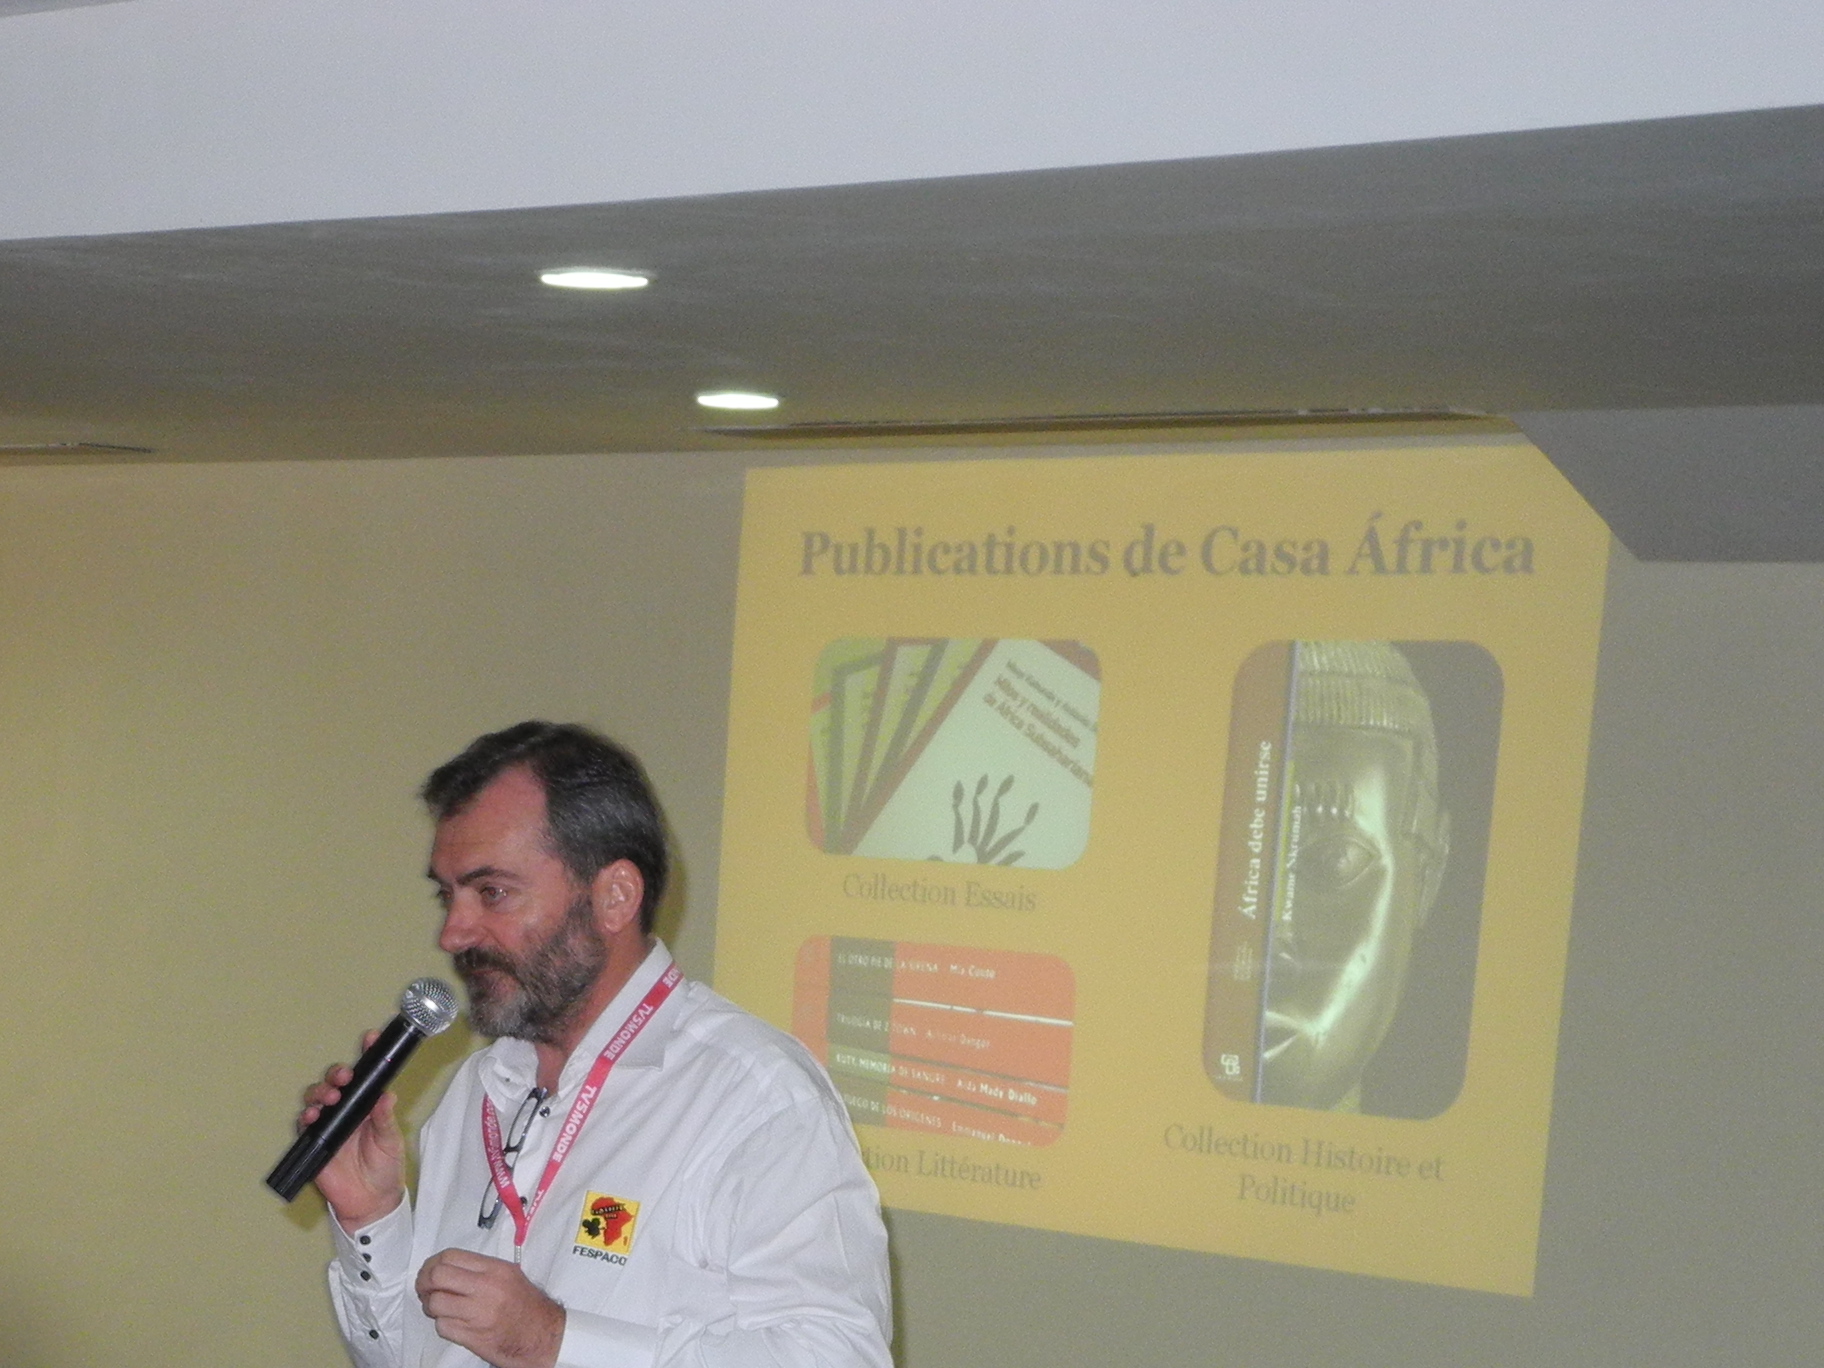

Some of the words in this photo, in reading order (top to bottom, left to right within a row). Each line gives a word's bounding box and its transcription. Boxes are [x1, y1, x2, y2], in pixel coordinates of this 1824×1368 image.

[798, 525, 1110, 577] Publications
[1122, 523, 1188, 577] de
[1201, 524, 1330, 576] Casa
[1348, 511, 1536, 576] África
[1254, 740, 1273, 802] unirse
[842, 872, 956, 907] Collection
[965, 881, 1037, 912] Essais
[603, 1002, 654, 1062] TV5MONDE
[552, 1084, 597, 1163] TV5MONDE
[917, 1148, 1042, 1190] Littérature
[1162, 1124, 1293, 1169] Collection
[1301, 1138, 1411, 1180] Histoire
[1419, 1155, 1444, 1182] et
[1237, 1172, 1357, 1217] Politique
[573, 1246, 628, 1267] FESPACO
